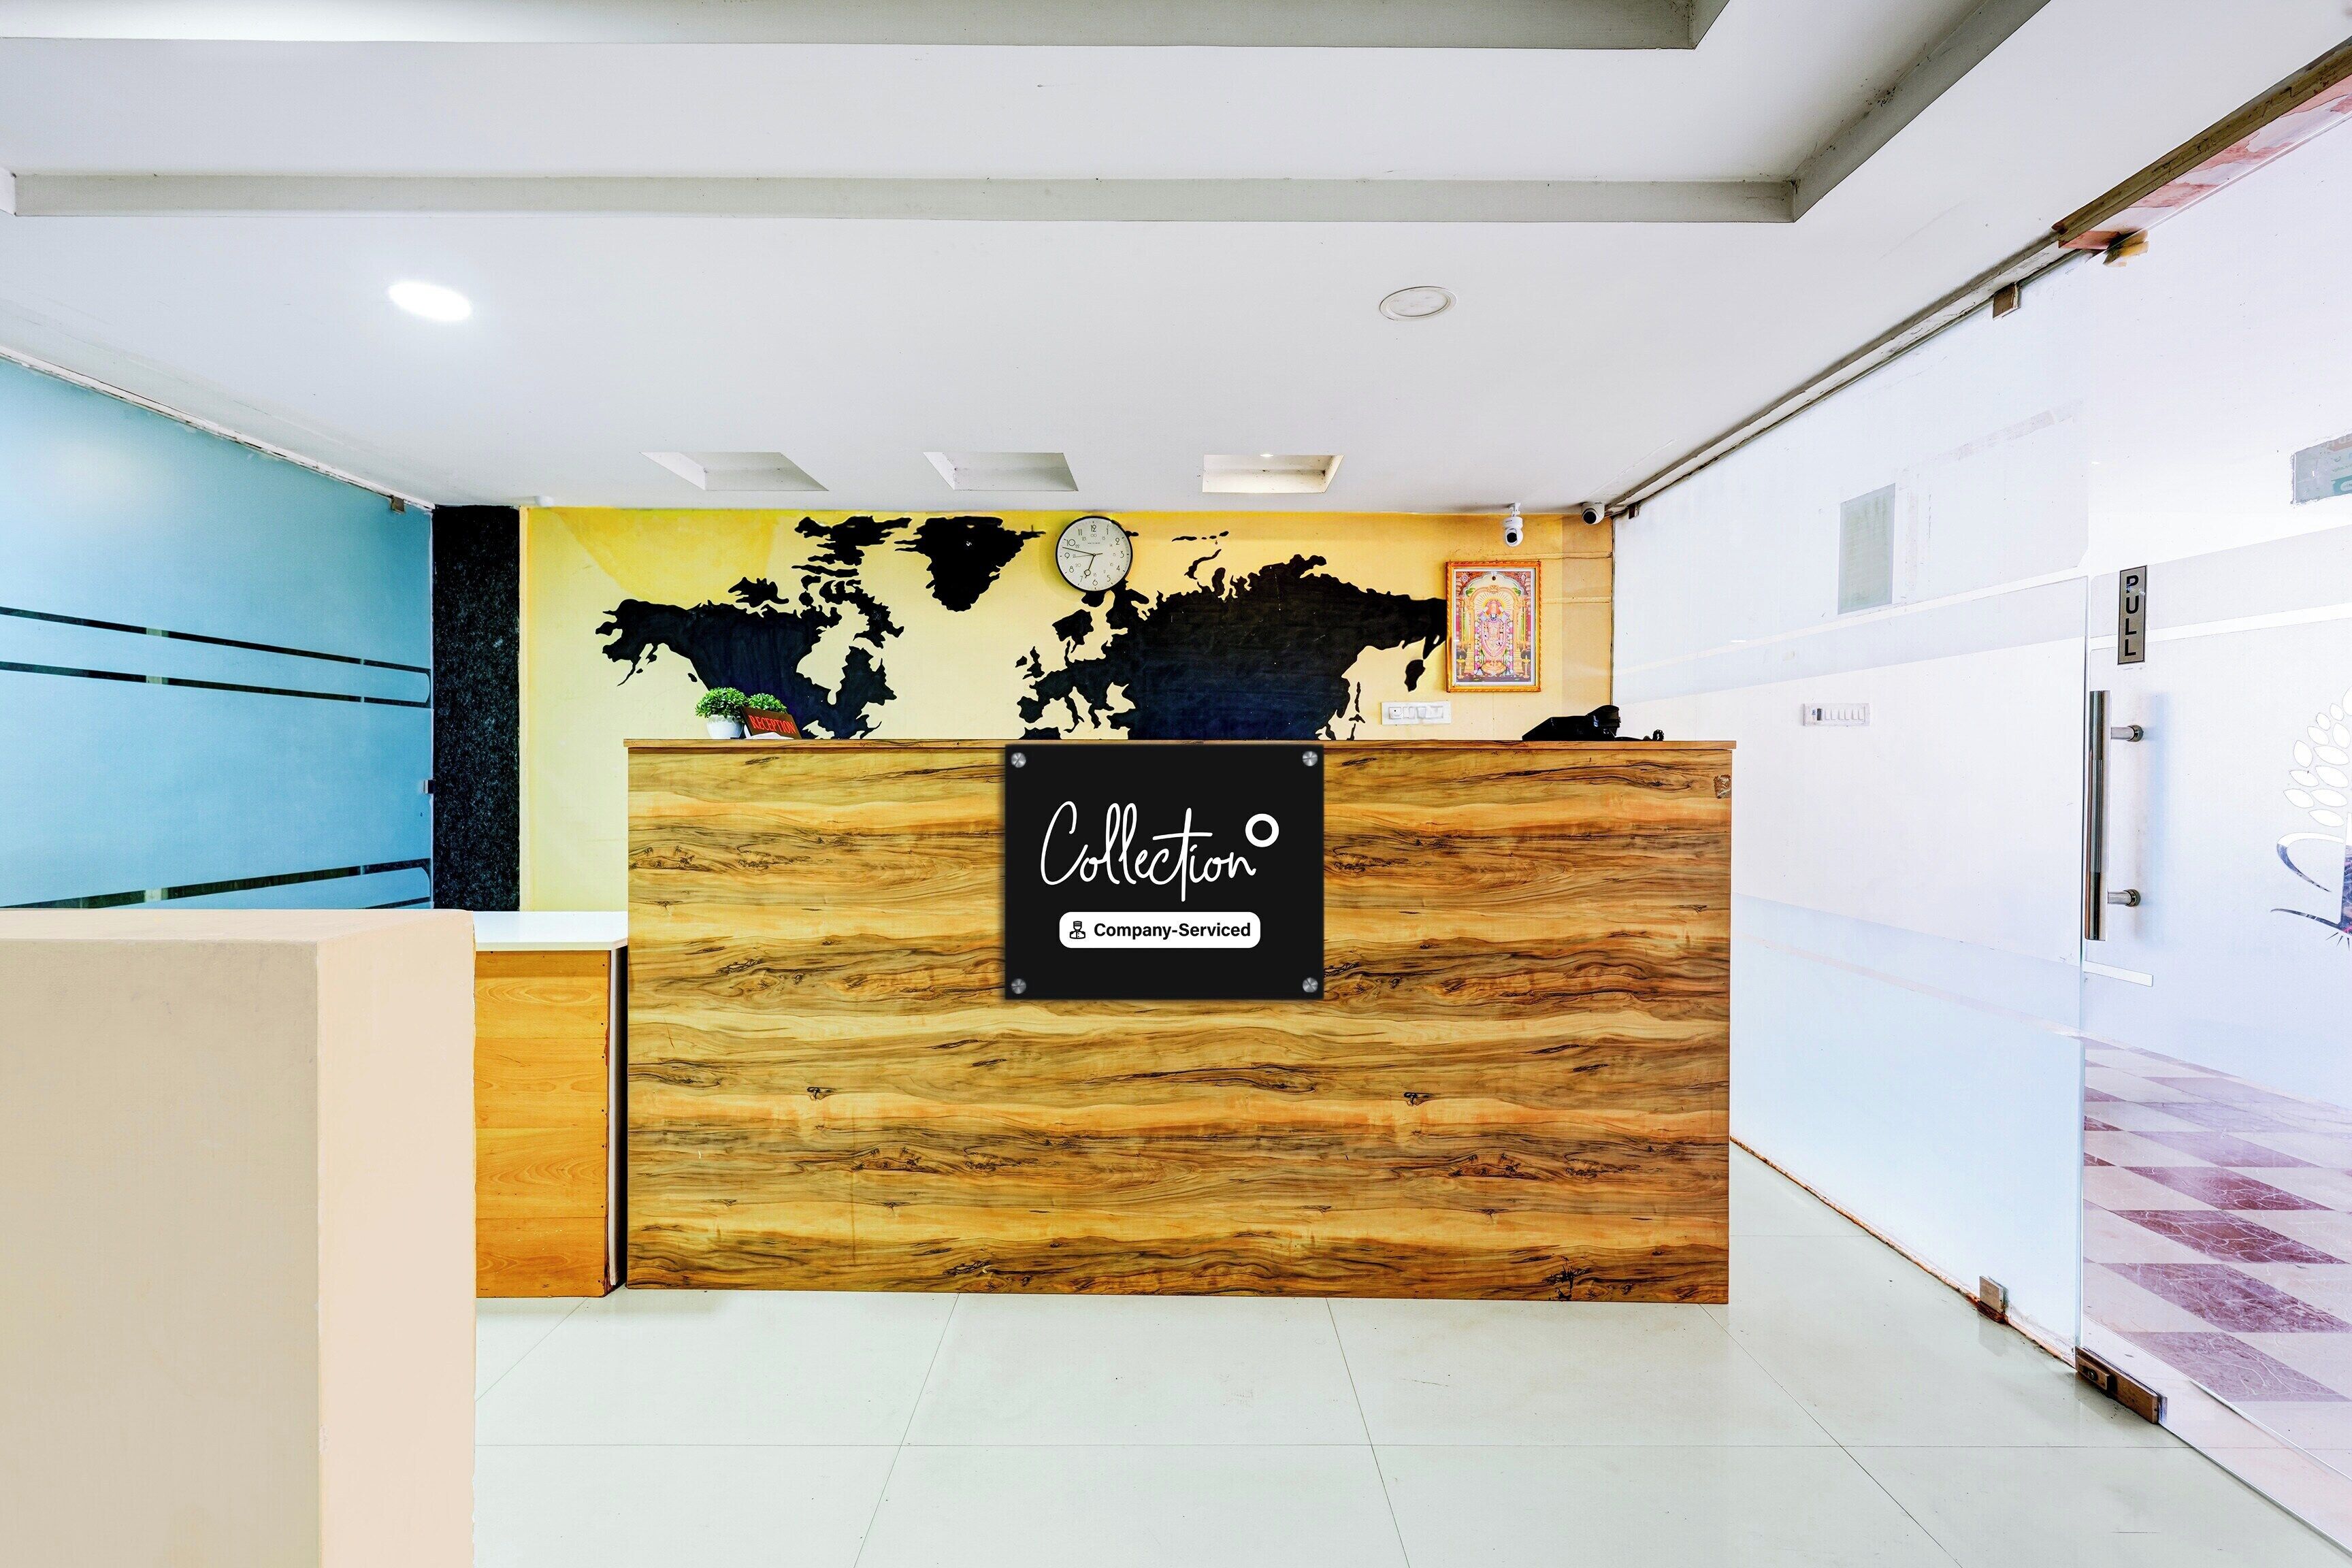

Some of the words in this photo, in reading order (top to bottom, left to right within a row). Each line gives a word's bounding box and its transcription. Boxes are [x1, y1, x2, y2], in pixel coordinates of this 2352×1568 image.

[1090, 524, 1096, 532] 12
[2125, 574, 2139, 657] PULL
[749, 715, 796, 734] RECEPTION
[1041, 801, 1256, 902] Collection
[1094, 923, 1251, 941] Company-Serviced
